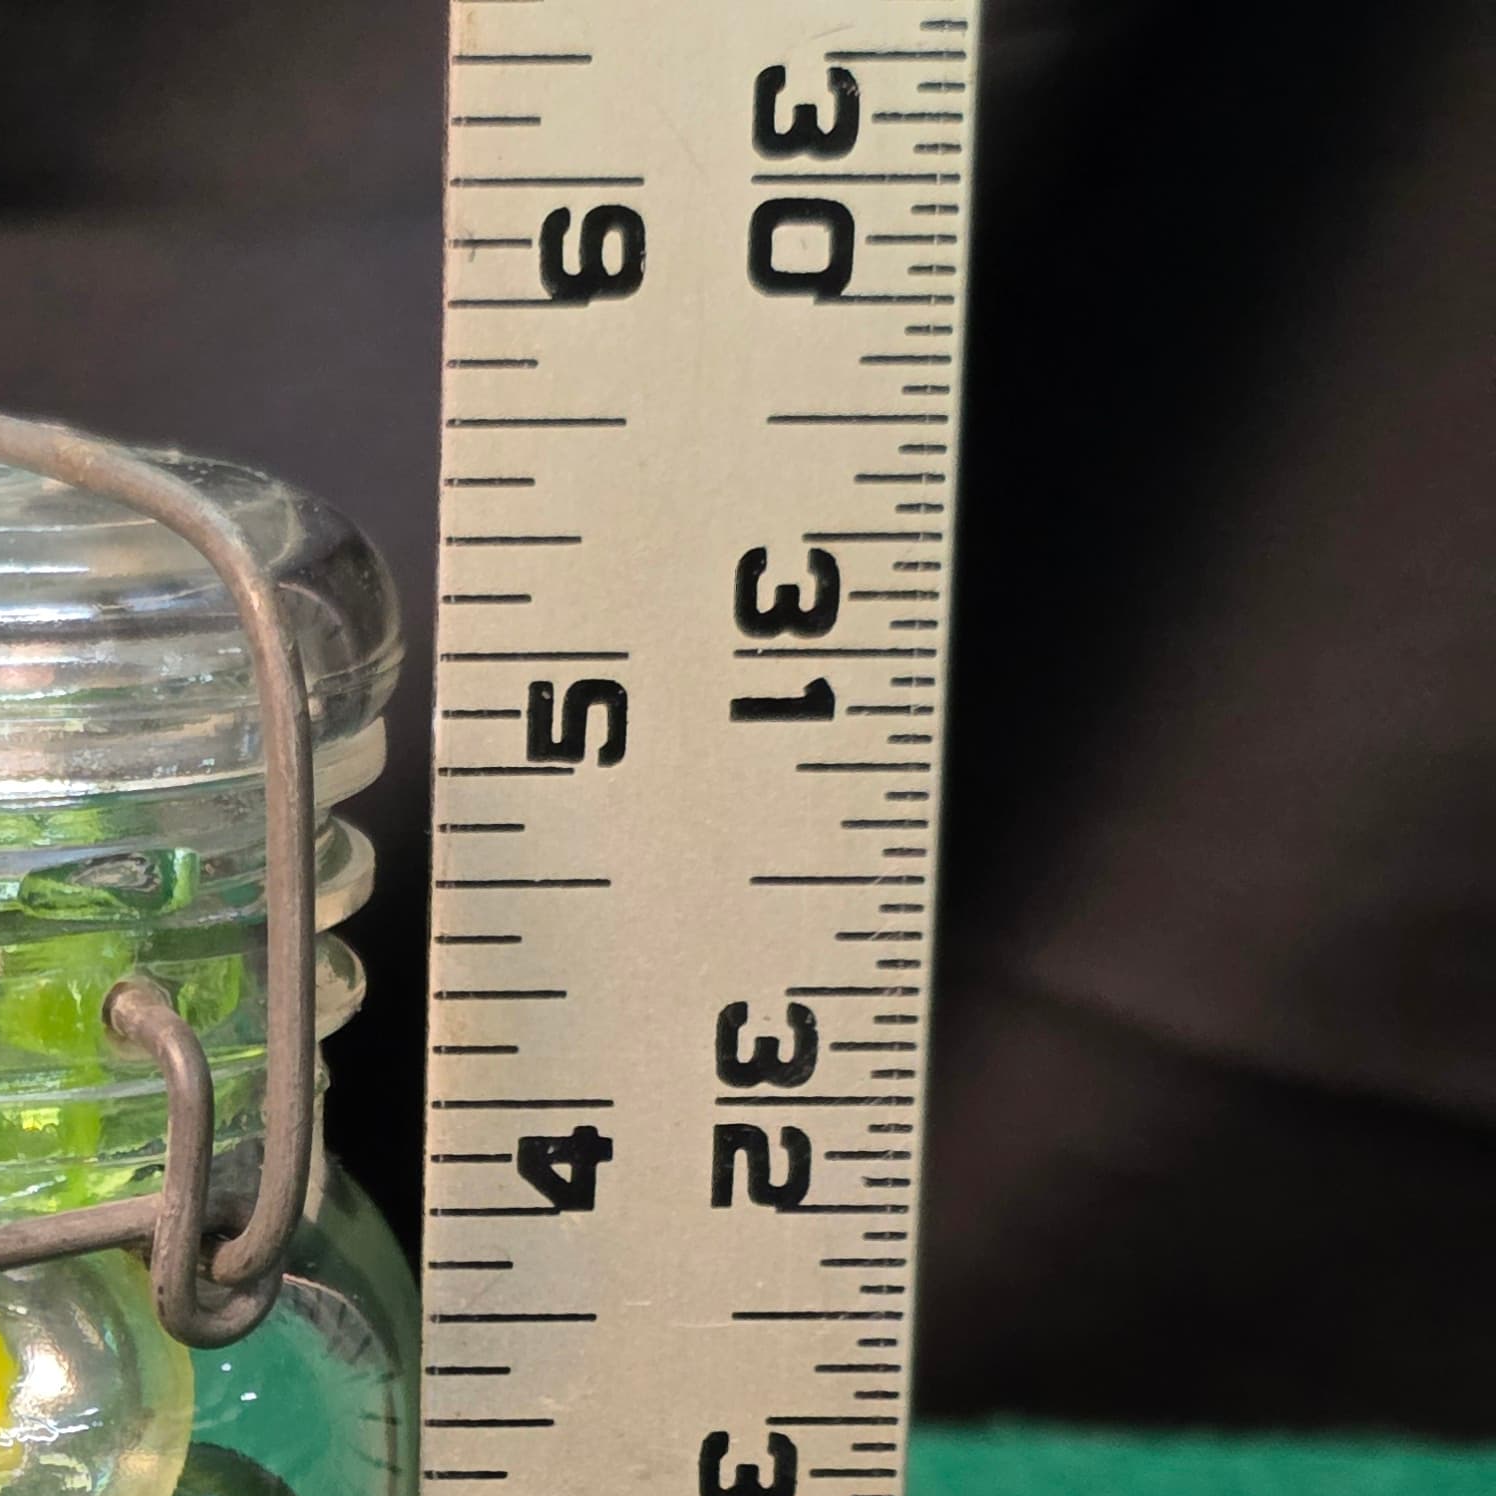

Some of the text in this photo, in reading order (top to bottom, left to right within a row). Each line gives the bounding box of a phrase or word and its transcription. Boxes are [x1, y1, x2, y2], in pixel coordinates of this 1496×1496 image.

[538, 204, 646, 301] 6
[527, 678, 628, 769] 5
[518, 1125, 613, 1212] 4
